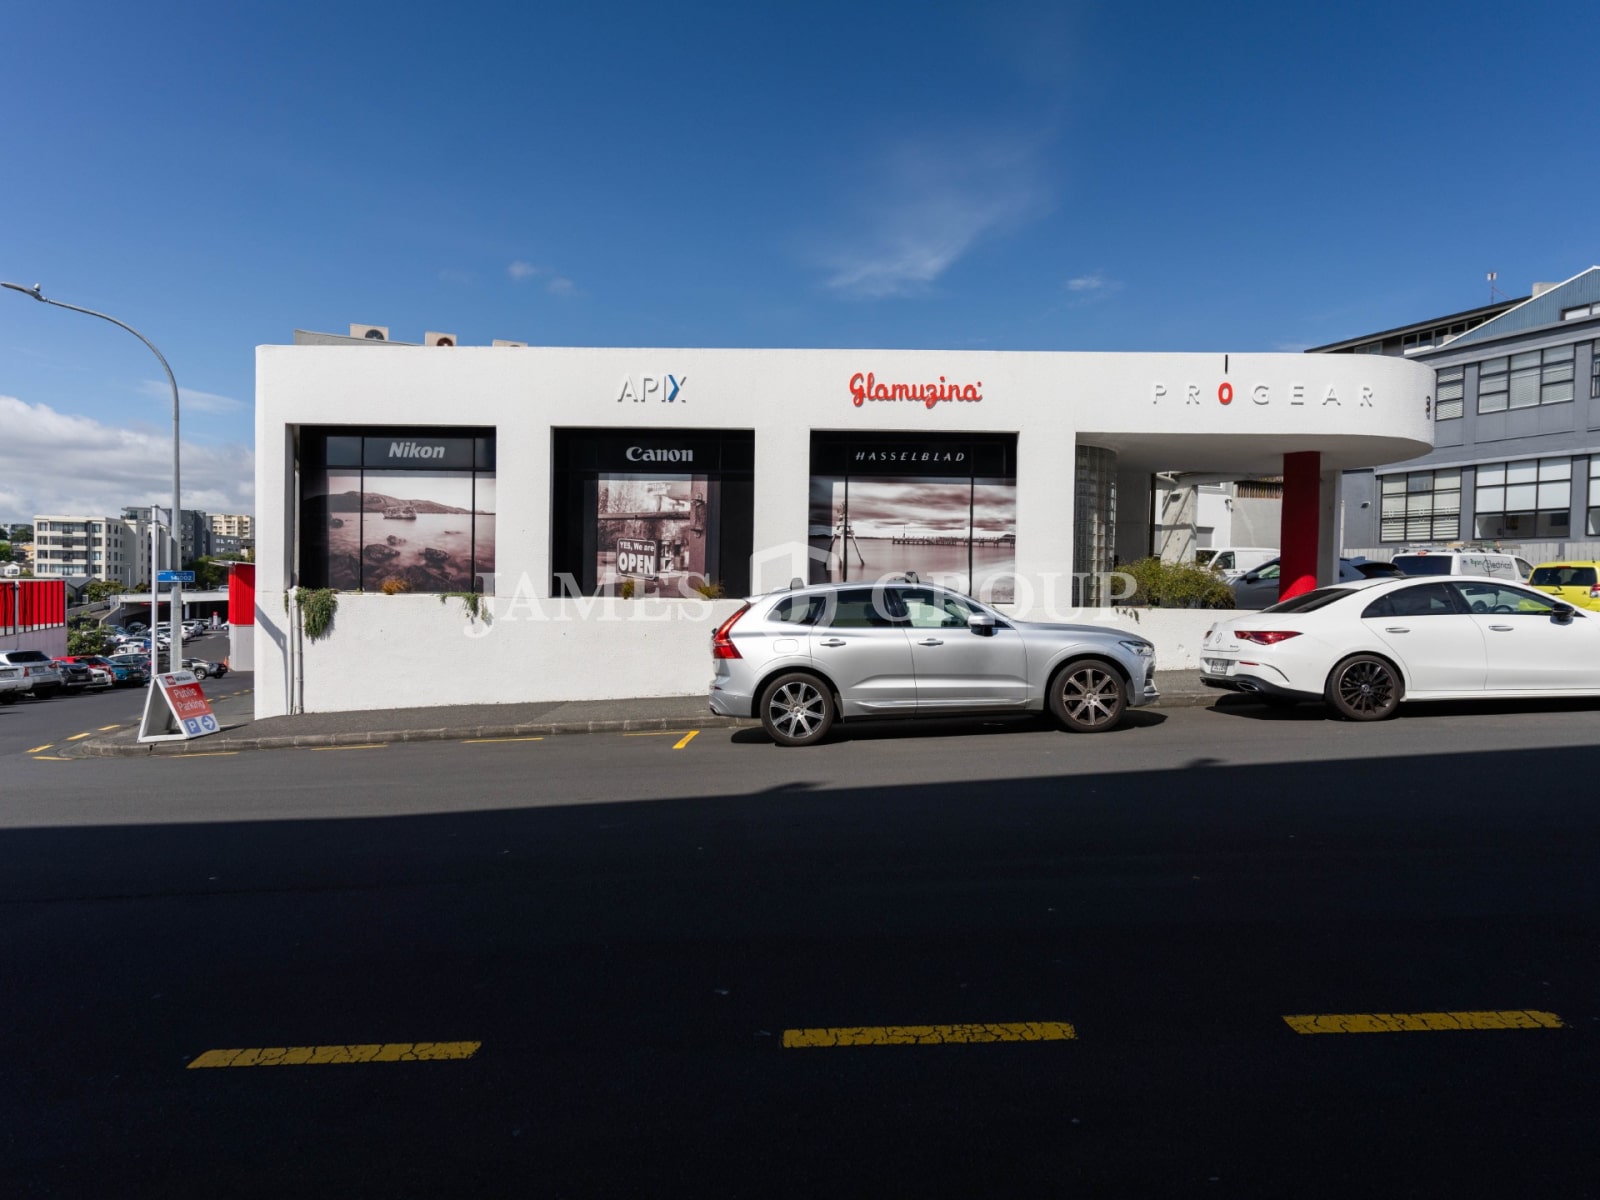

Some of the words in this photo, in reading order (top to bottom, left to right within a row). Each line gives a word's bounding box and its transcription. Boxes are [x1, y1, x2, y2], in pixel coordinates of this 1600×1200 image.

[616, 373, 687, 403] APIX
[849, 371, 983, 410] Glamuzina
[1152, 381, 1374, 408] PROGEAR
[388, 441, 446, 459] Nikon
[625, 446, 694, 462] Canon
[855, 451, 966, 463] HASSELBLAD
[633, 542, 643, 551] We
[618, 551, 655, 576] OPEN
[173, 687, 198, 699] Public
[177, 699, 206, 712] Parking
